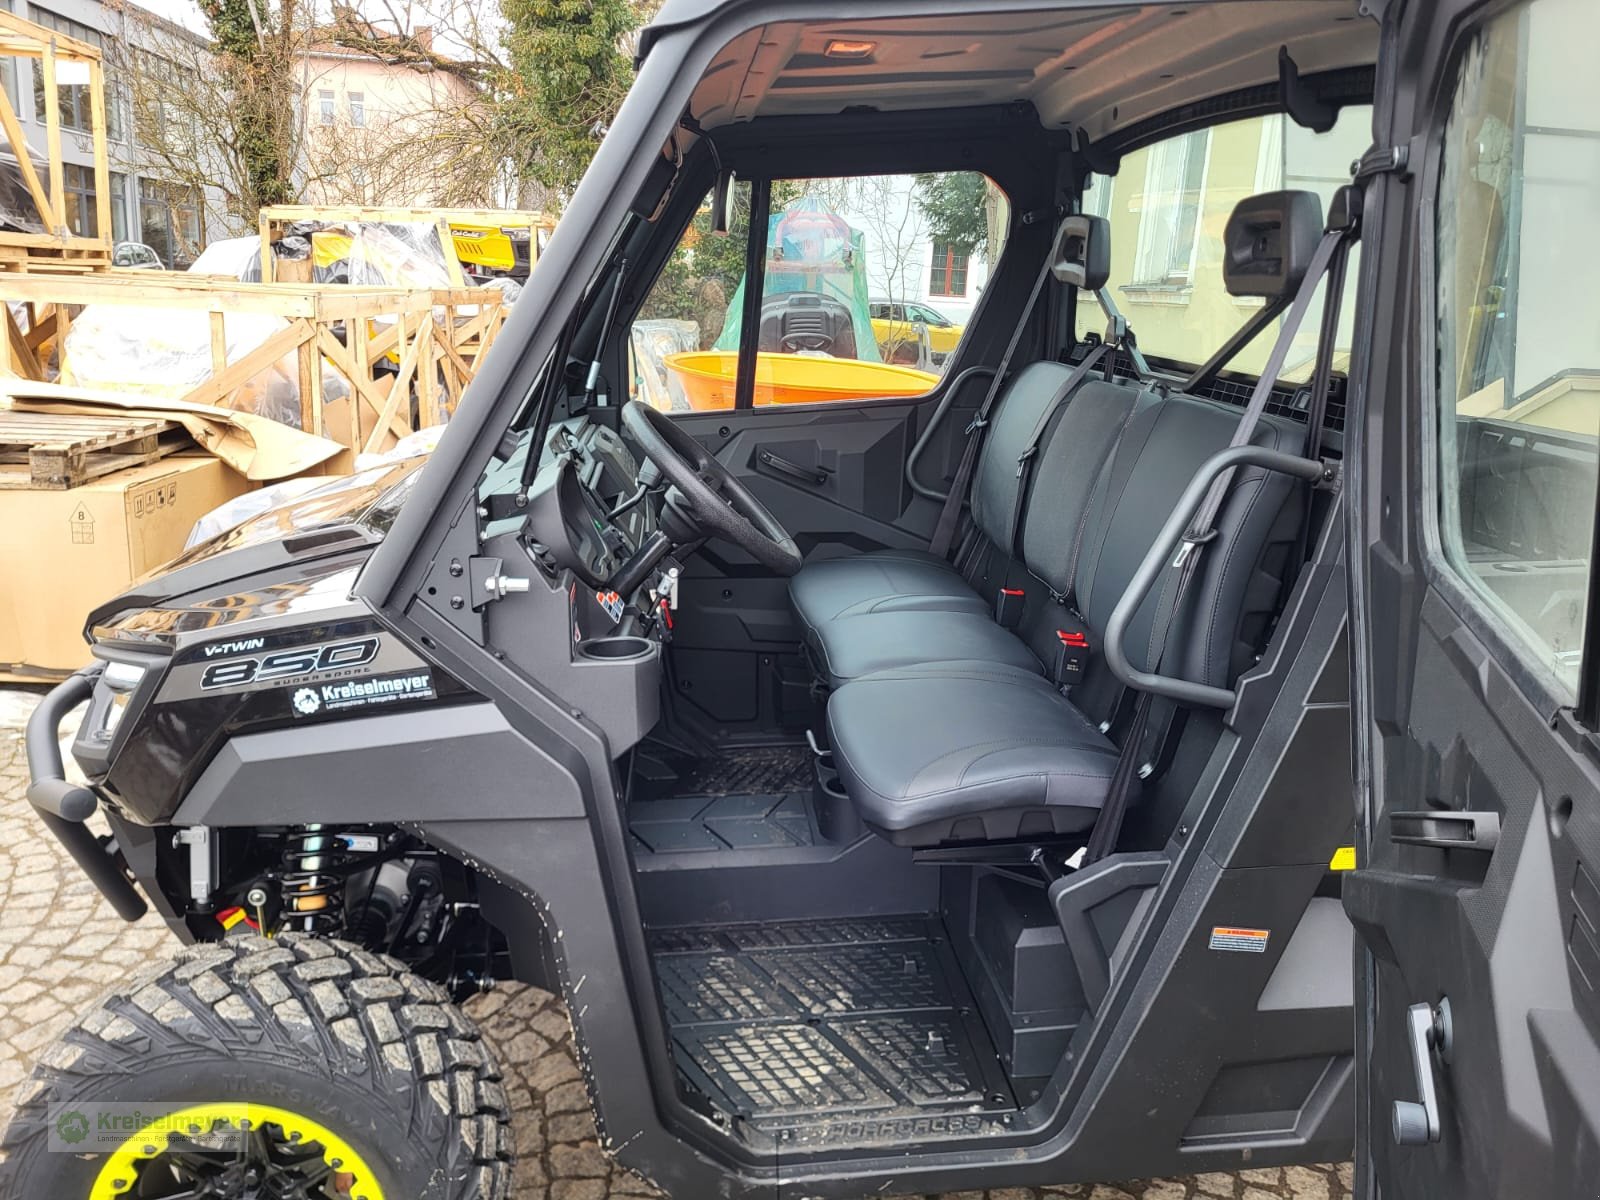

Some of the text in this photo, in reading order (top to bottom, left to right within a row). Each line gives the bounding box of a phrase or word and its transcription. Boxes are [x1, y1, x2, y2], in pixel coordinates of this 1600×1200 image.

[204, 638, 264, 657] V-TWIN
[200, 637, 381, 691] 850
[321, 675, 429, 701] Kreiselmeyer
